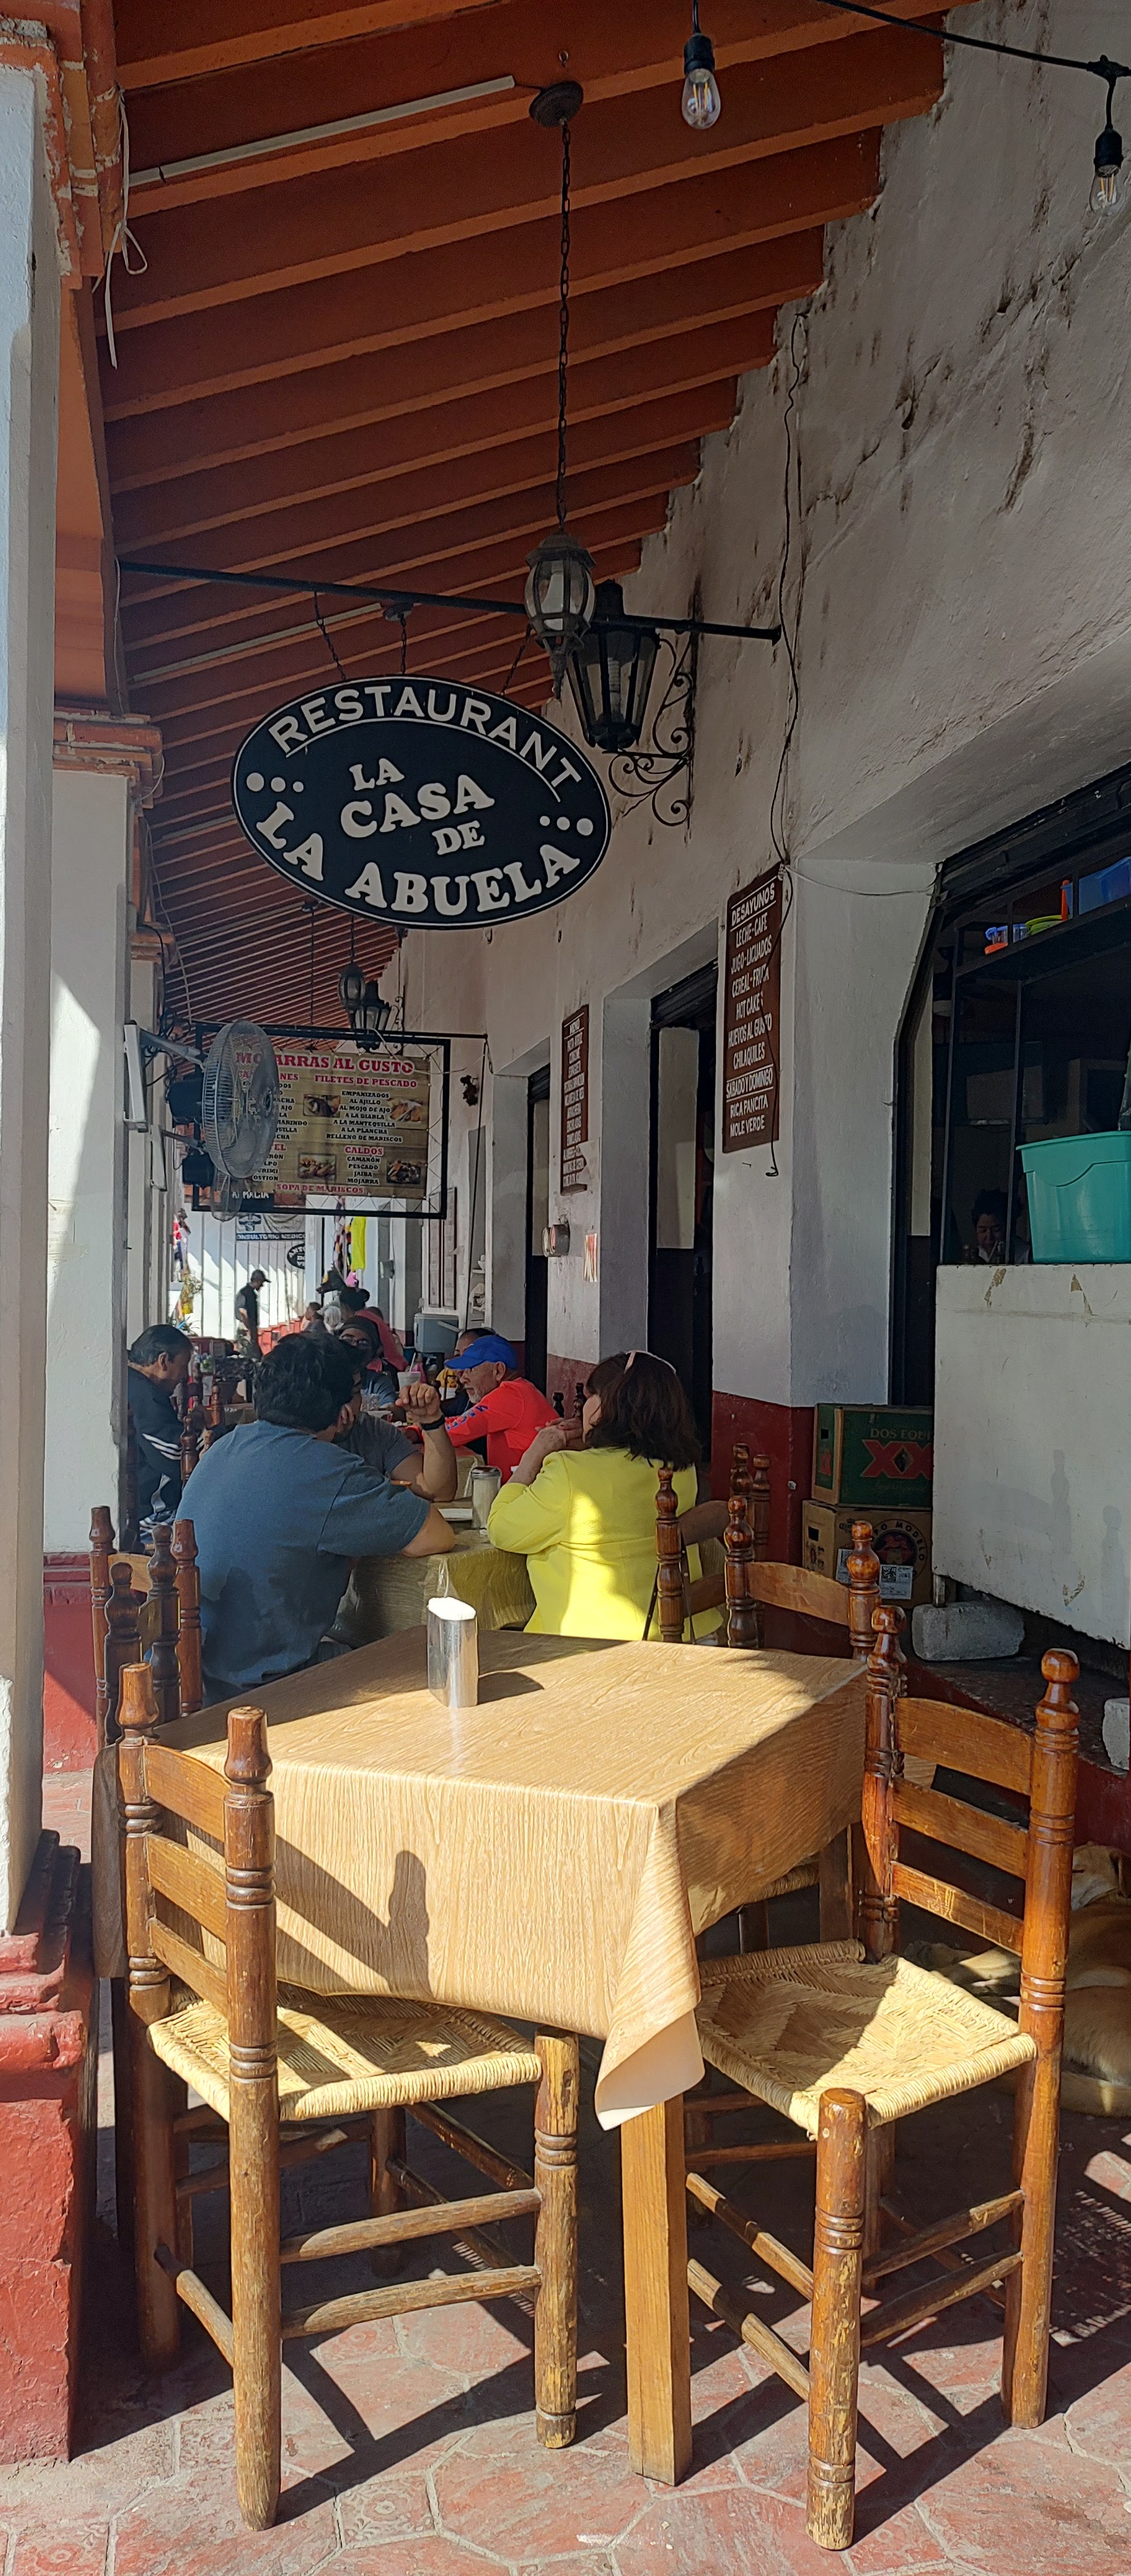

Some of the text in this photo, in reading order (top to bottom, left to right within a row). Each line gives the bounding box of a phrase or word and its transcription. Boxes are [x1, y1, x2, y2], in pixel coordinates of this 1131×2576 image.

[268, 685, 582, 788] RESTAURANT
[348, 757, 405, 791] LA
[340, 774, 495, 838] CASA
[432, 820, 486, 855] DE
[256, 801, 580, 916] LA ABUELA
[732, 882, 775, 927] DESAYUNOS
[736, 999, 746, 1021] HOT
[728, 1012, 772, 1049] HUEVOS AL GUSTO
[236, 1052, 413, 1074] MOARRAS AL GUSTO
[733, 1041, 765, 1070] CHILAQUILES
[314, 1075, 417, 1088] FILETES DE PESCADO
[341, 1090, 390, 1099] EMPANIZADOS
[726, 1067, 773, 1099] SABADO Y DOMINGO
[730, 1094, 768, 1119] RICA PANCITA
[730, 1114, 766, 1138] MOLE VERDE
[345, 1146, 384, 1155] CALDOS
[870, 1428, 897, 1439] DOS
[895, 1521, 926, 1561] MODELO
